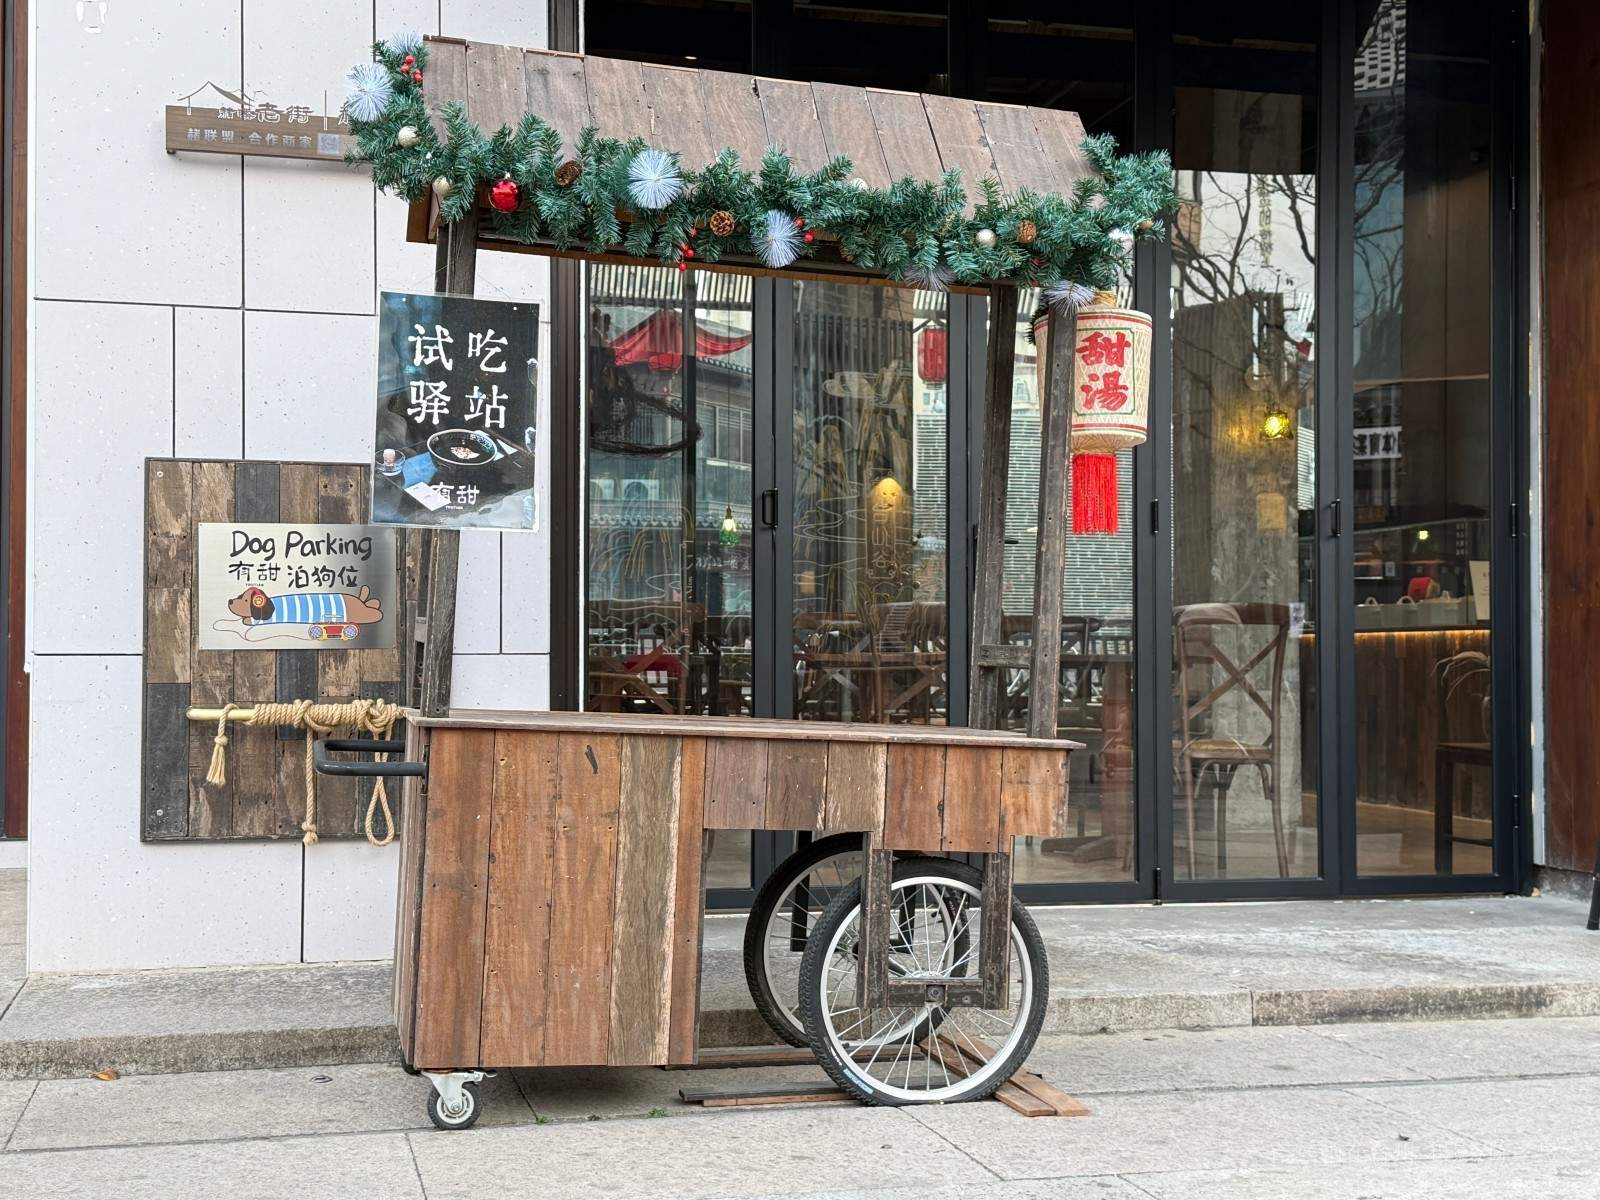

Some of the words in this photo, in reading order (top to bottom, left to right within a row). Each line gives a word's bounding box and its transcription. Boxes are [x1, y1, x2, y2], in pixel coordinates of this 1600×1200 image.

[408, 323, 508, 373] 试吃
[1075, 331, 1132, 411] 甜湯
[407, 379, 509, 429] 驿站
[430, 481, 480, 505] 有甜
[230, 530, 276, 561] Dog
[285, 530, 373, 561] Parking
[228, 560, 281, 582] 有甜
[287, 564, 361, 589] 泊狗位
